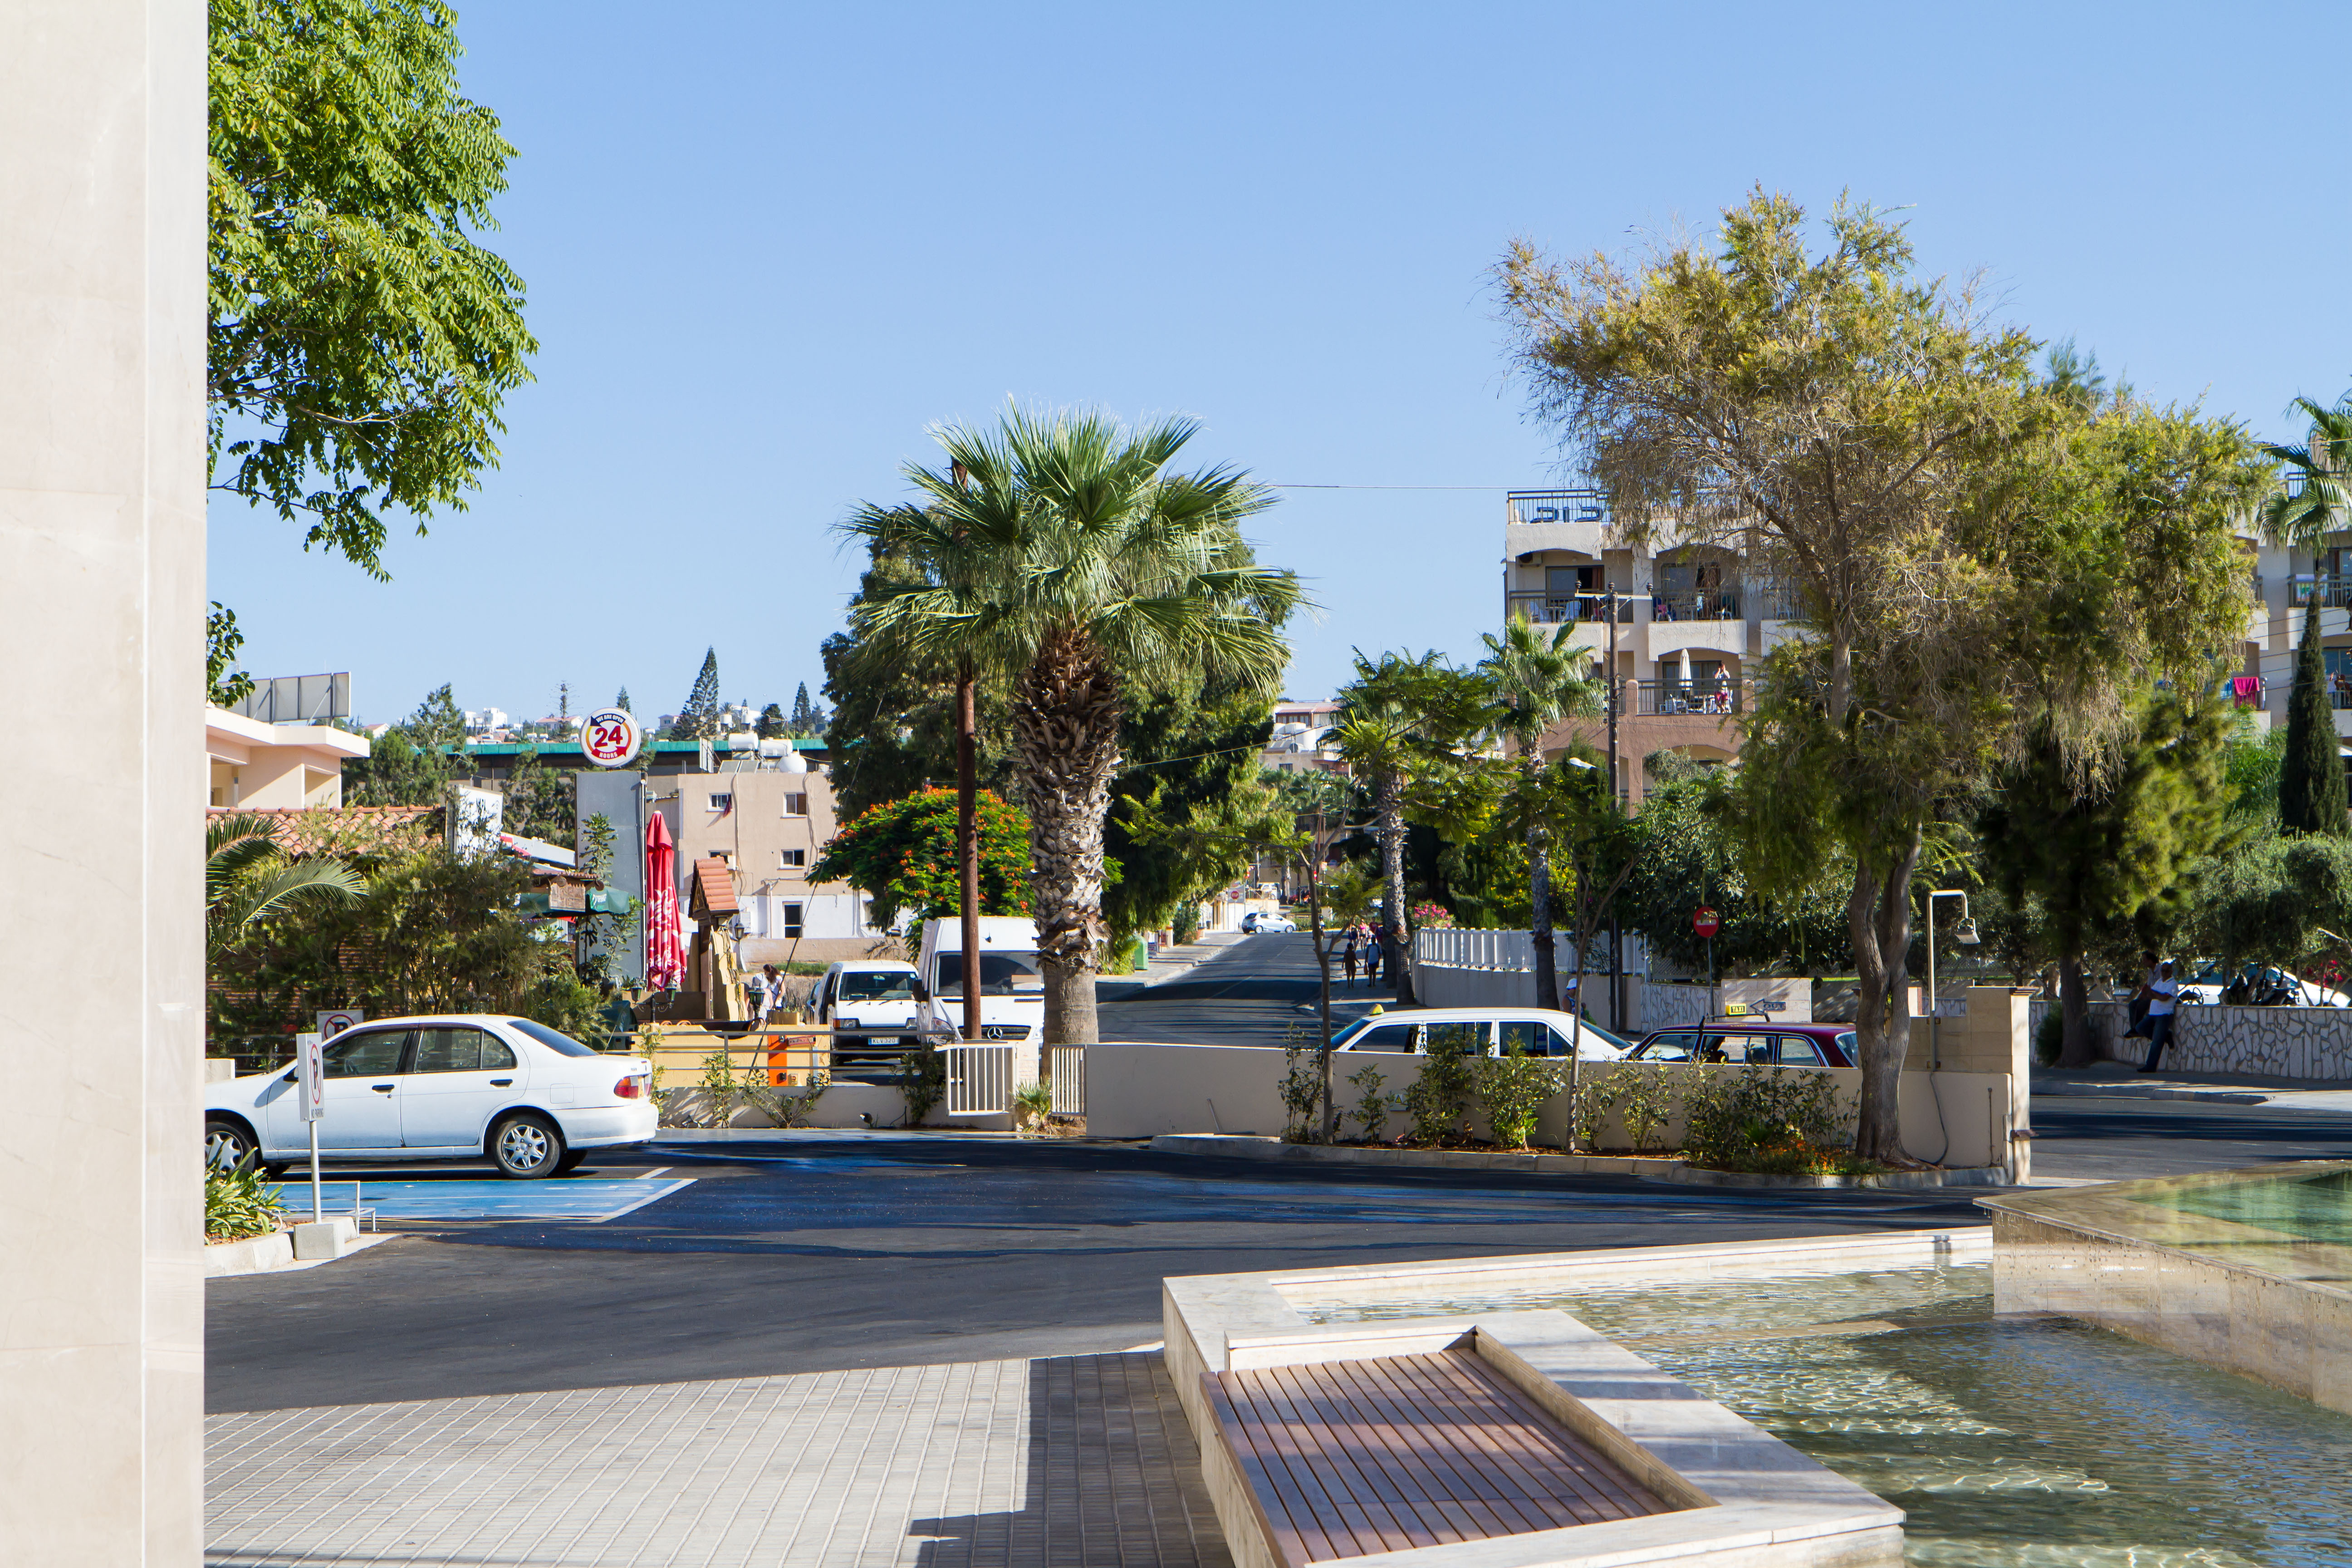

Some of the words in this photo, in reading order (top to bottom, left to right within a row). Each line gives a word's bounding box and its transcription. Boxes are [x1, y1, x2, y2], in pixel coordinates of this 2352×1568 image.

[612, 715, 624, 723] OPEN
[594, 725, 623, 748] 24
[313, 1058, 318, 1089] P
